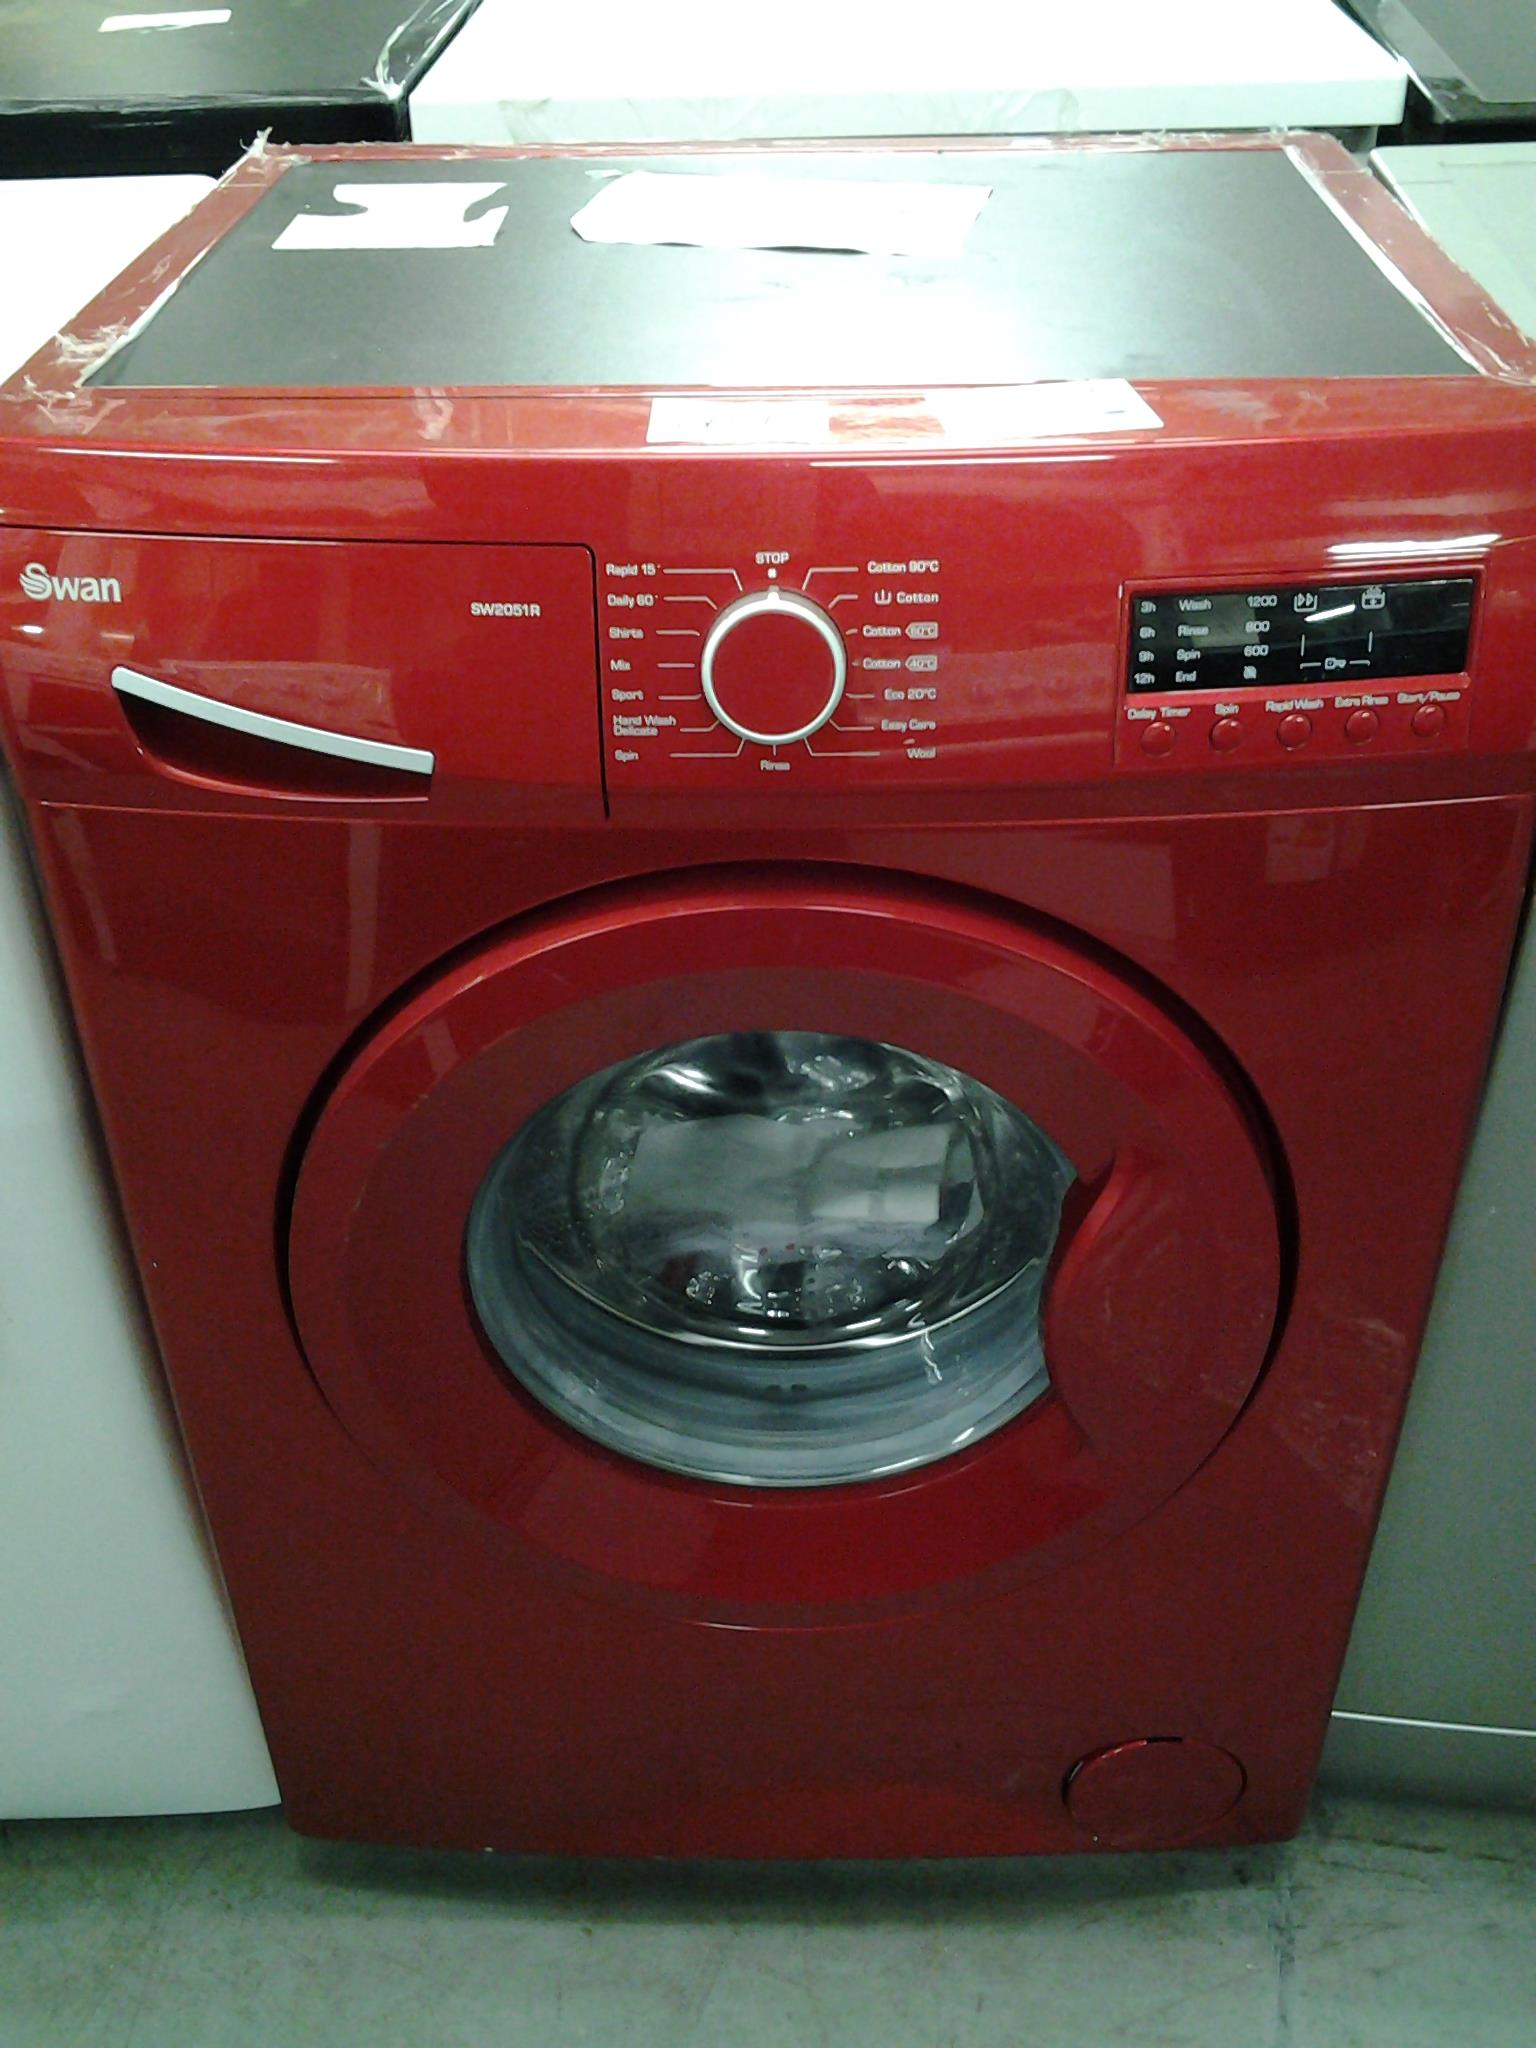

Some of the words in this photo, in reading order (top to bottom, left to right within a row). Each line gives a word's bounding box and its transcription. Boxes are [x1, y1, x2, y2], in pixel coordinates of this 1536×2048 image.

[755, 551, 790, 565] STOP
[605, 562, 638, 578] Rapid
[867, 560, 906, 574] Cotton
[19, 562, 122, 603] Swan
[607, 593, 635, 609] Daily
[896, 591, 939, 605] Cotton
[1247, 594, 1278, 608] 1200
[470, 602, 541, 617] SW2051R
[1178, 599, 1212, 612] Wash
[863, 624, 902, 638] Cotton
[1177, 624, 1209, 637] Rinse
[1176, 648, 1201, 663] Spin
[863, 657, 901, 671] Cotton
[1134, 672, 1156, 684] 12h
[1175, 670, 1197, 683] End
[611, 688, 644, 702] Sport
